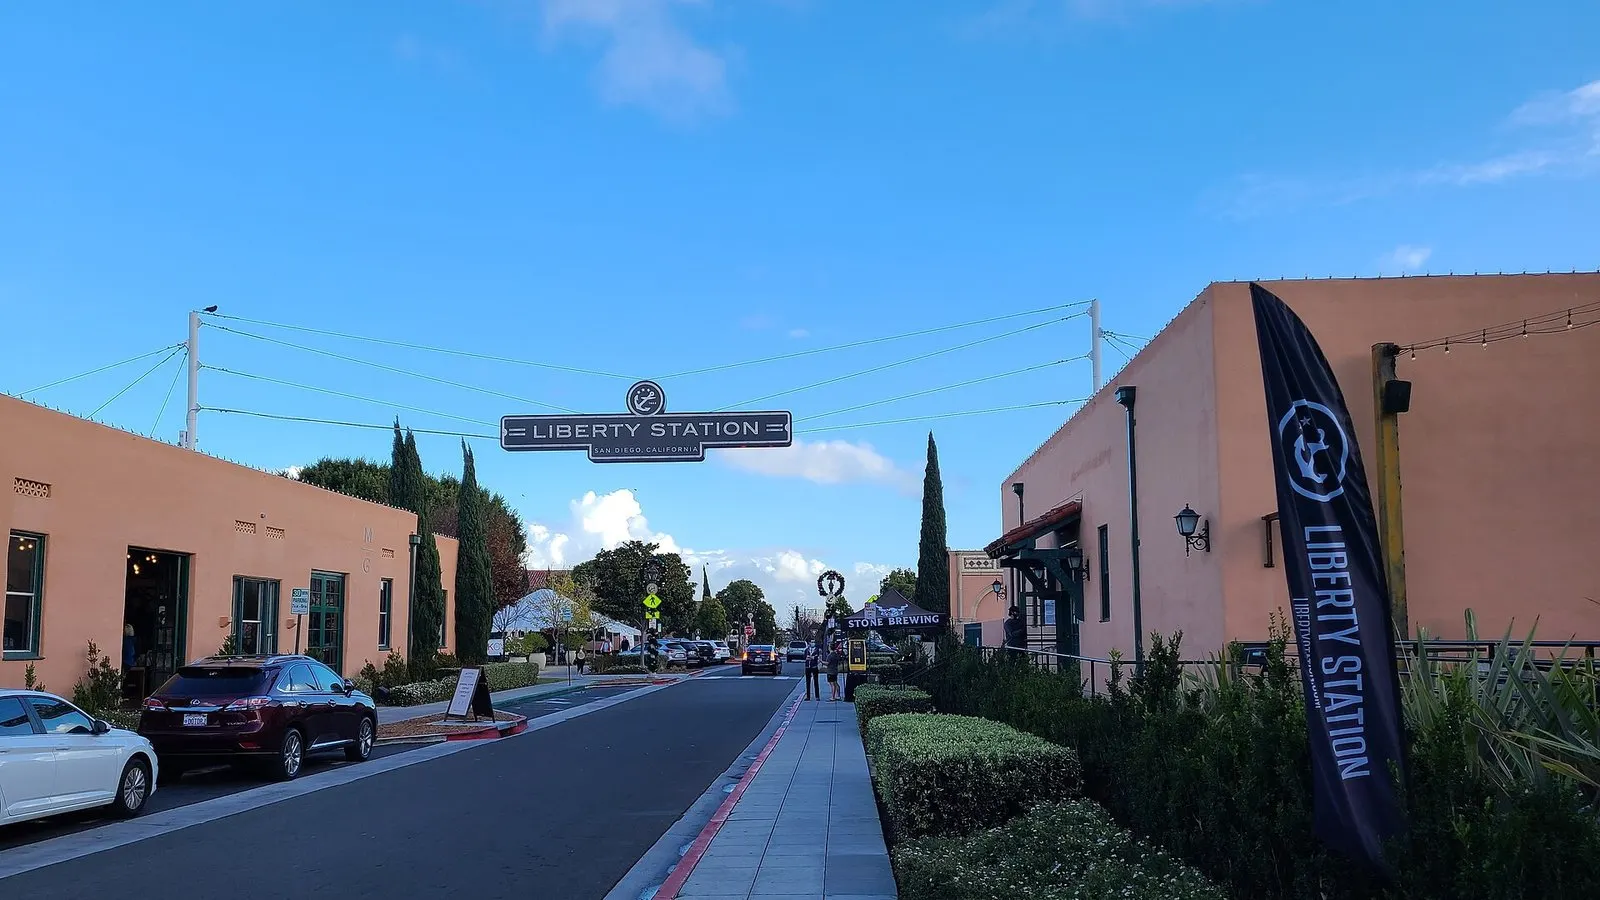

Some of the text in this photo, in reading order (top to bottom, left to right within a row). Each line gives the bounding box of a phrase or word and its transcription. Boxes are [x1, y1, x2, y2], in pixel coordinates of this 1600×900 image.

[533, 421, 759, 439] LIBERTY STATION
[848, 615, 939, 628] STONE BREWING
[1304, 525, 1370, 780] LIBERTY STATION
